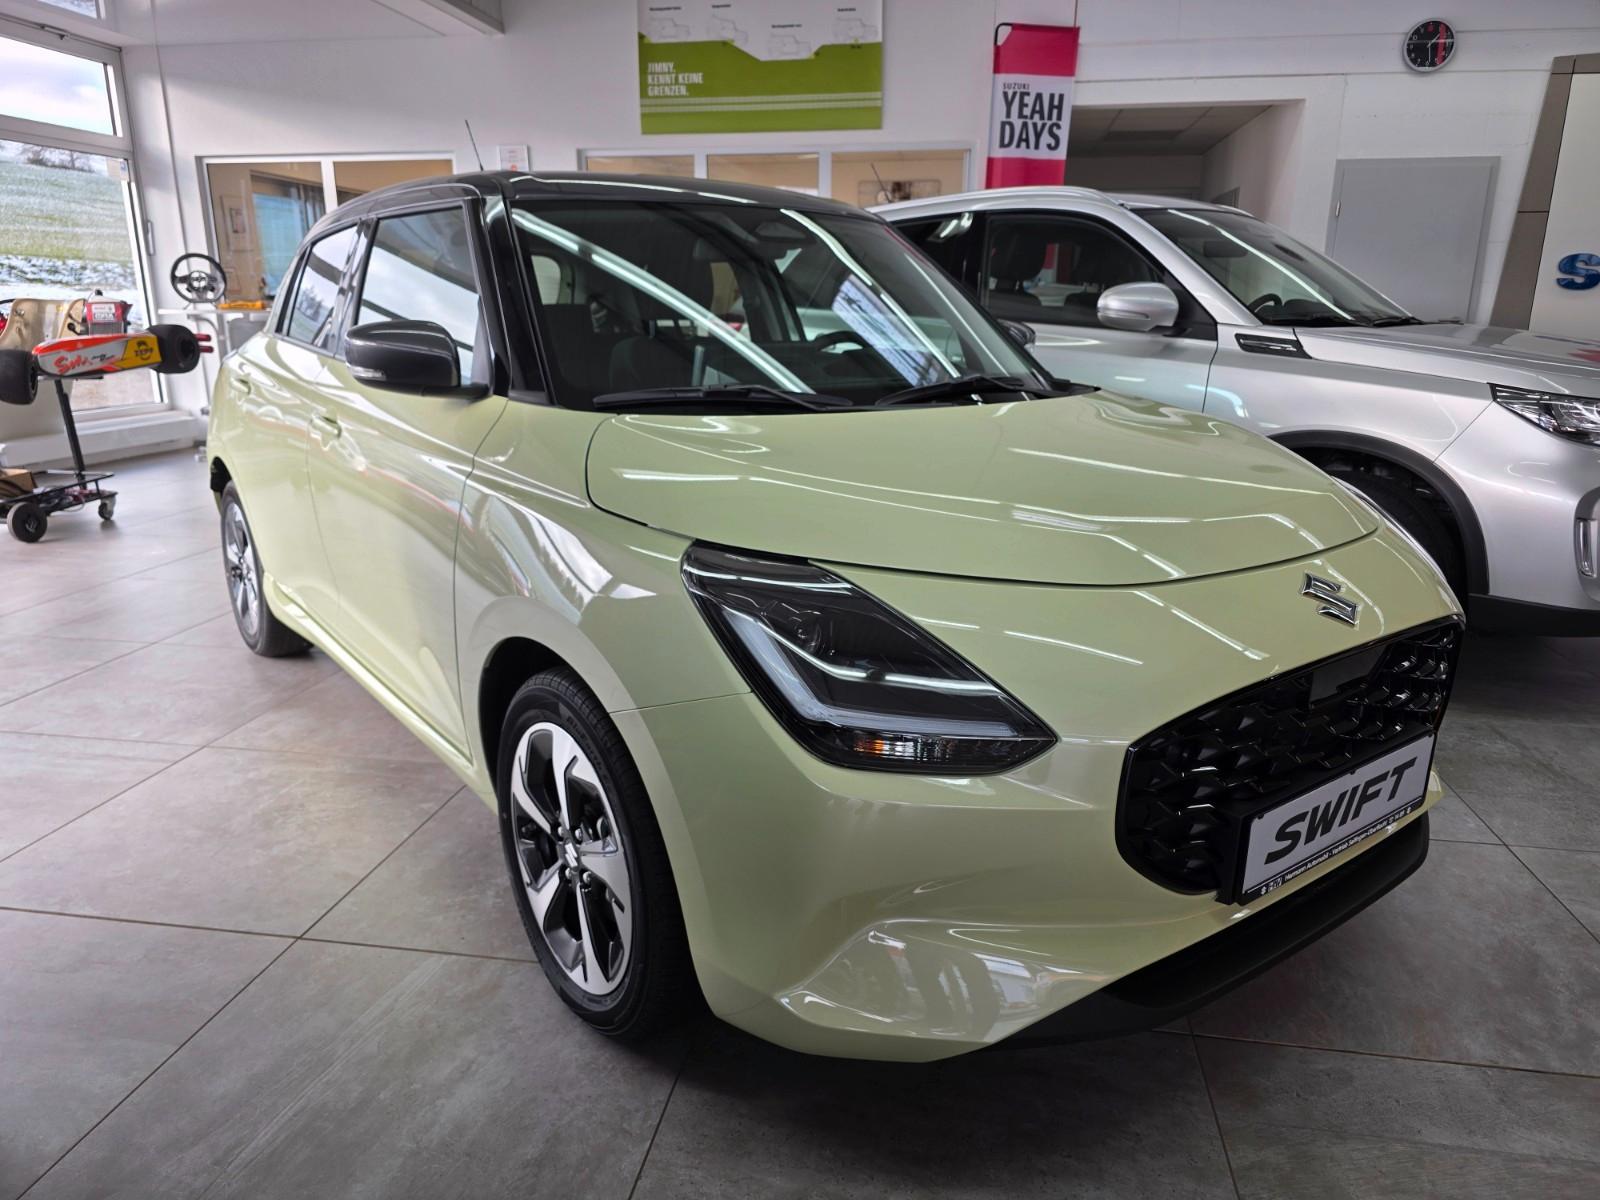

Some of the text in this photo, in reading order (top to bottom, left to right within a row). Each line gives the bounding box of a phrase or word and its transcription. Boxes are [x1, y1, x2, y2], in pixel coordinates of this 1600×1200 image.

[647, 72, 704, 85] KENNT KEINE
[1003, 82, 1031, 90] SUZUKI
[1002, 90, 1065, 122] YEAH
[999, 120, 1062, 151] DAYS
[1264, 756, 1418, 865] SWIFT
